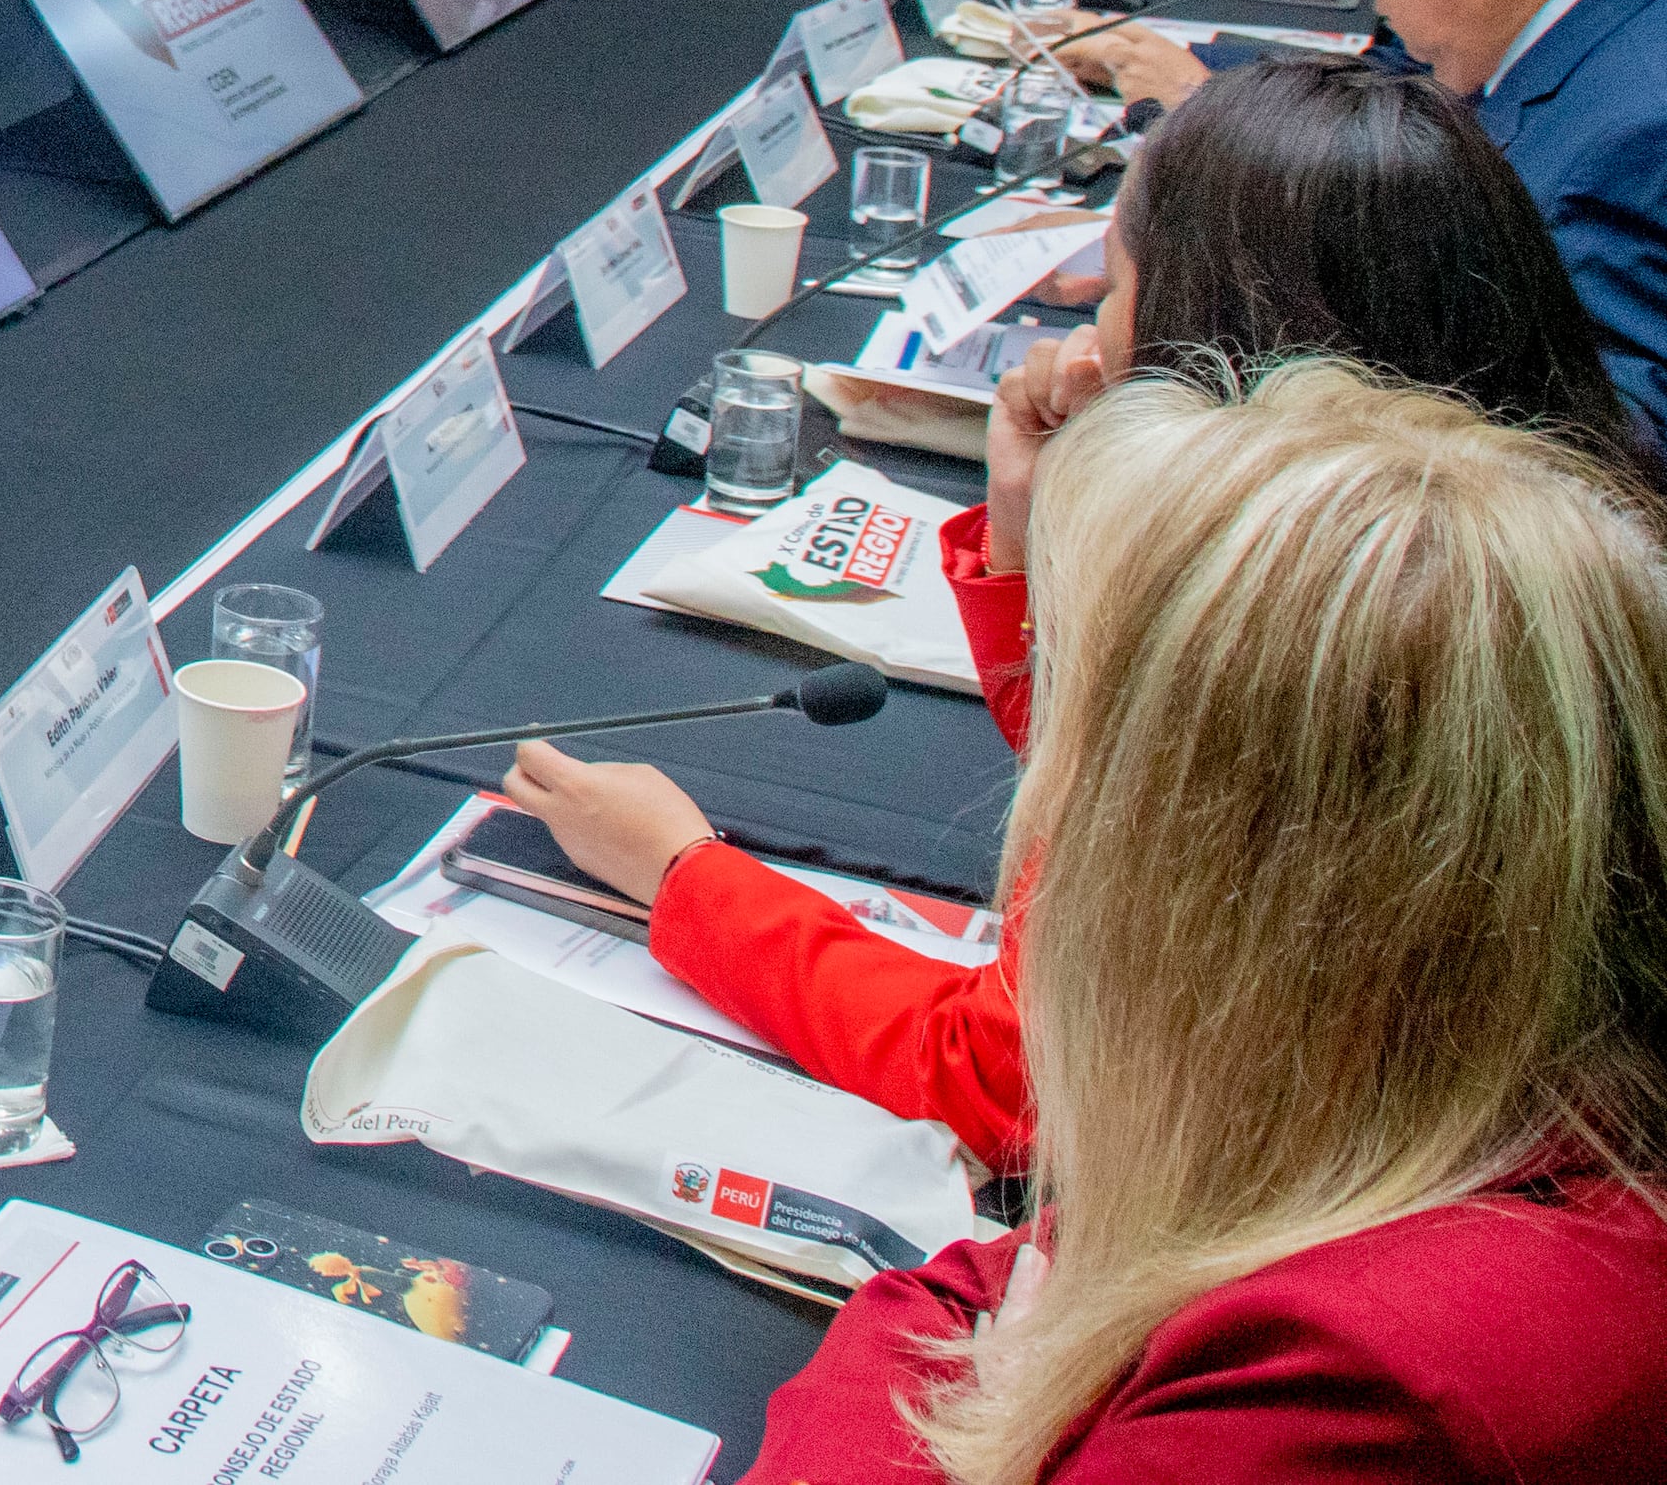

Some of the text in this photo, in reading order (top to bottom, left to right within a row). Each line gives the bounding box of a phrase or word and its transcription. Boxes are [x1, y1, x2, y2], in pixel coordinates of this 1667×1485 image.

[802, 496, 871, 571] ESTAD
[805, 503, 825, 518] de
[848, 506, 910, 581] REGIO
[46, 666, 118, 748] Edith Pariona Valer
[351, 1114, 432, 1134] del Perú
[720, 1185, 761, 1210] PERÚ
[770, 1214, 860, 1245] del Consejo de
[773, 1200, 843, 1229] Presidencia
[148, 1363, 243, 1456] CARPETA
[207, 1358, 324, 1485] ONSEJO DE ESTADO
[388, 1390, 445, 1459] Altabás Kajatt
[258, 1411, 326, 1481] REGIONAL
